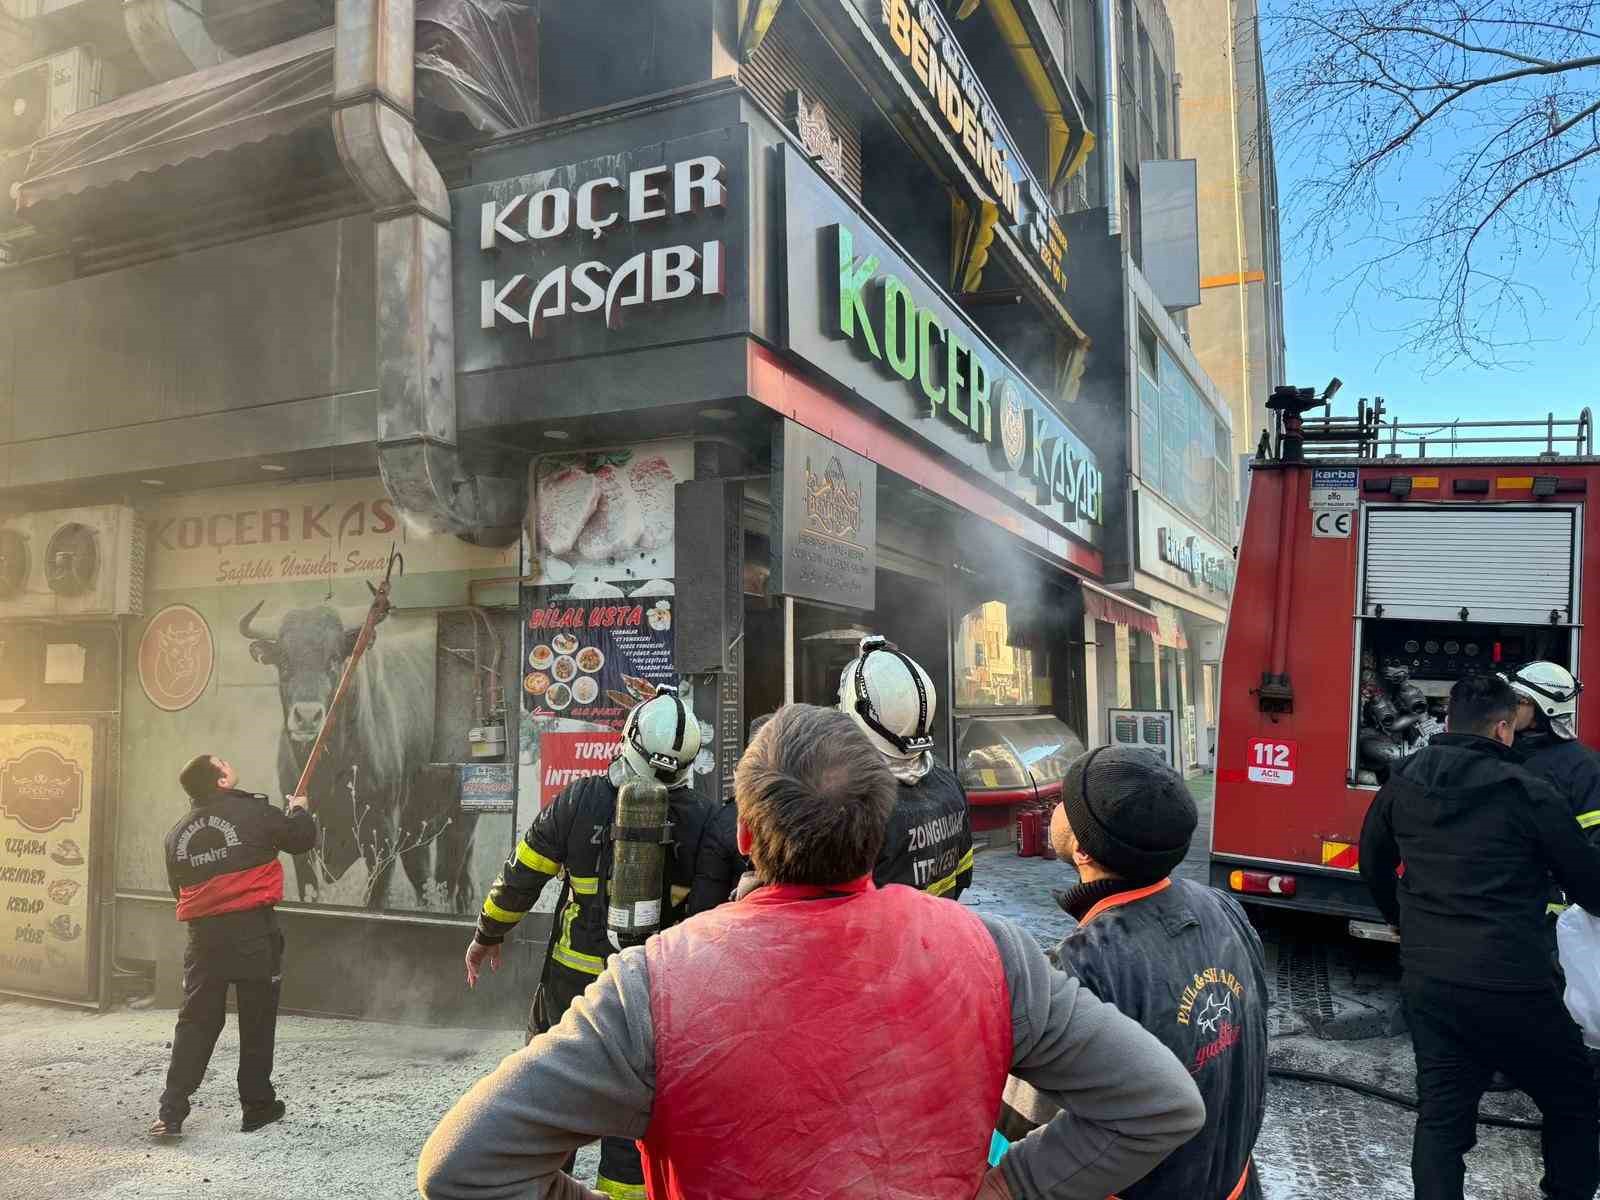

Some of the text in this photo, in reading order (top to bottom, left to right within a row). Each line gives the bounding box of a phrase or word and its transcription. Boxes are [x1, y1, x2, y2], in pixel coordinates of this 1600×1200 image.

[481, 155, 724, 250] KOÇER
[481, 240, 724, 340] KASABI
[838, 223, 992, 442] KOÇER
[1033, 409, 1103, 528] KASABI
[1315, 470, 1355, 479] karba
[148, 499, 398, 554] KOÇER KAS
[529, 603, 642, 629] BİLAL USTA
[1254, 742, 1290, 767] 112
